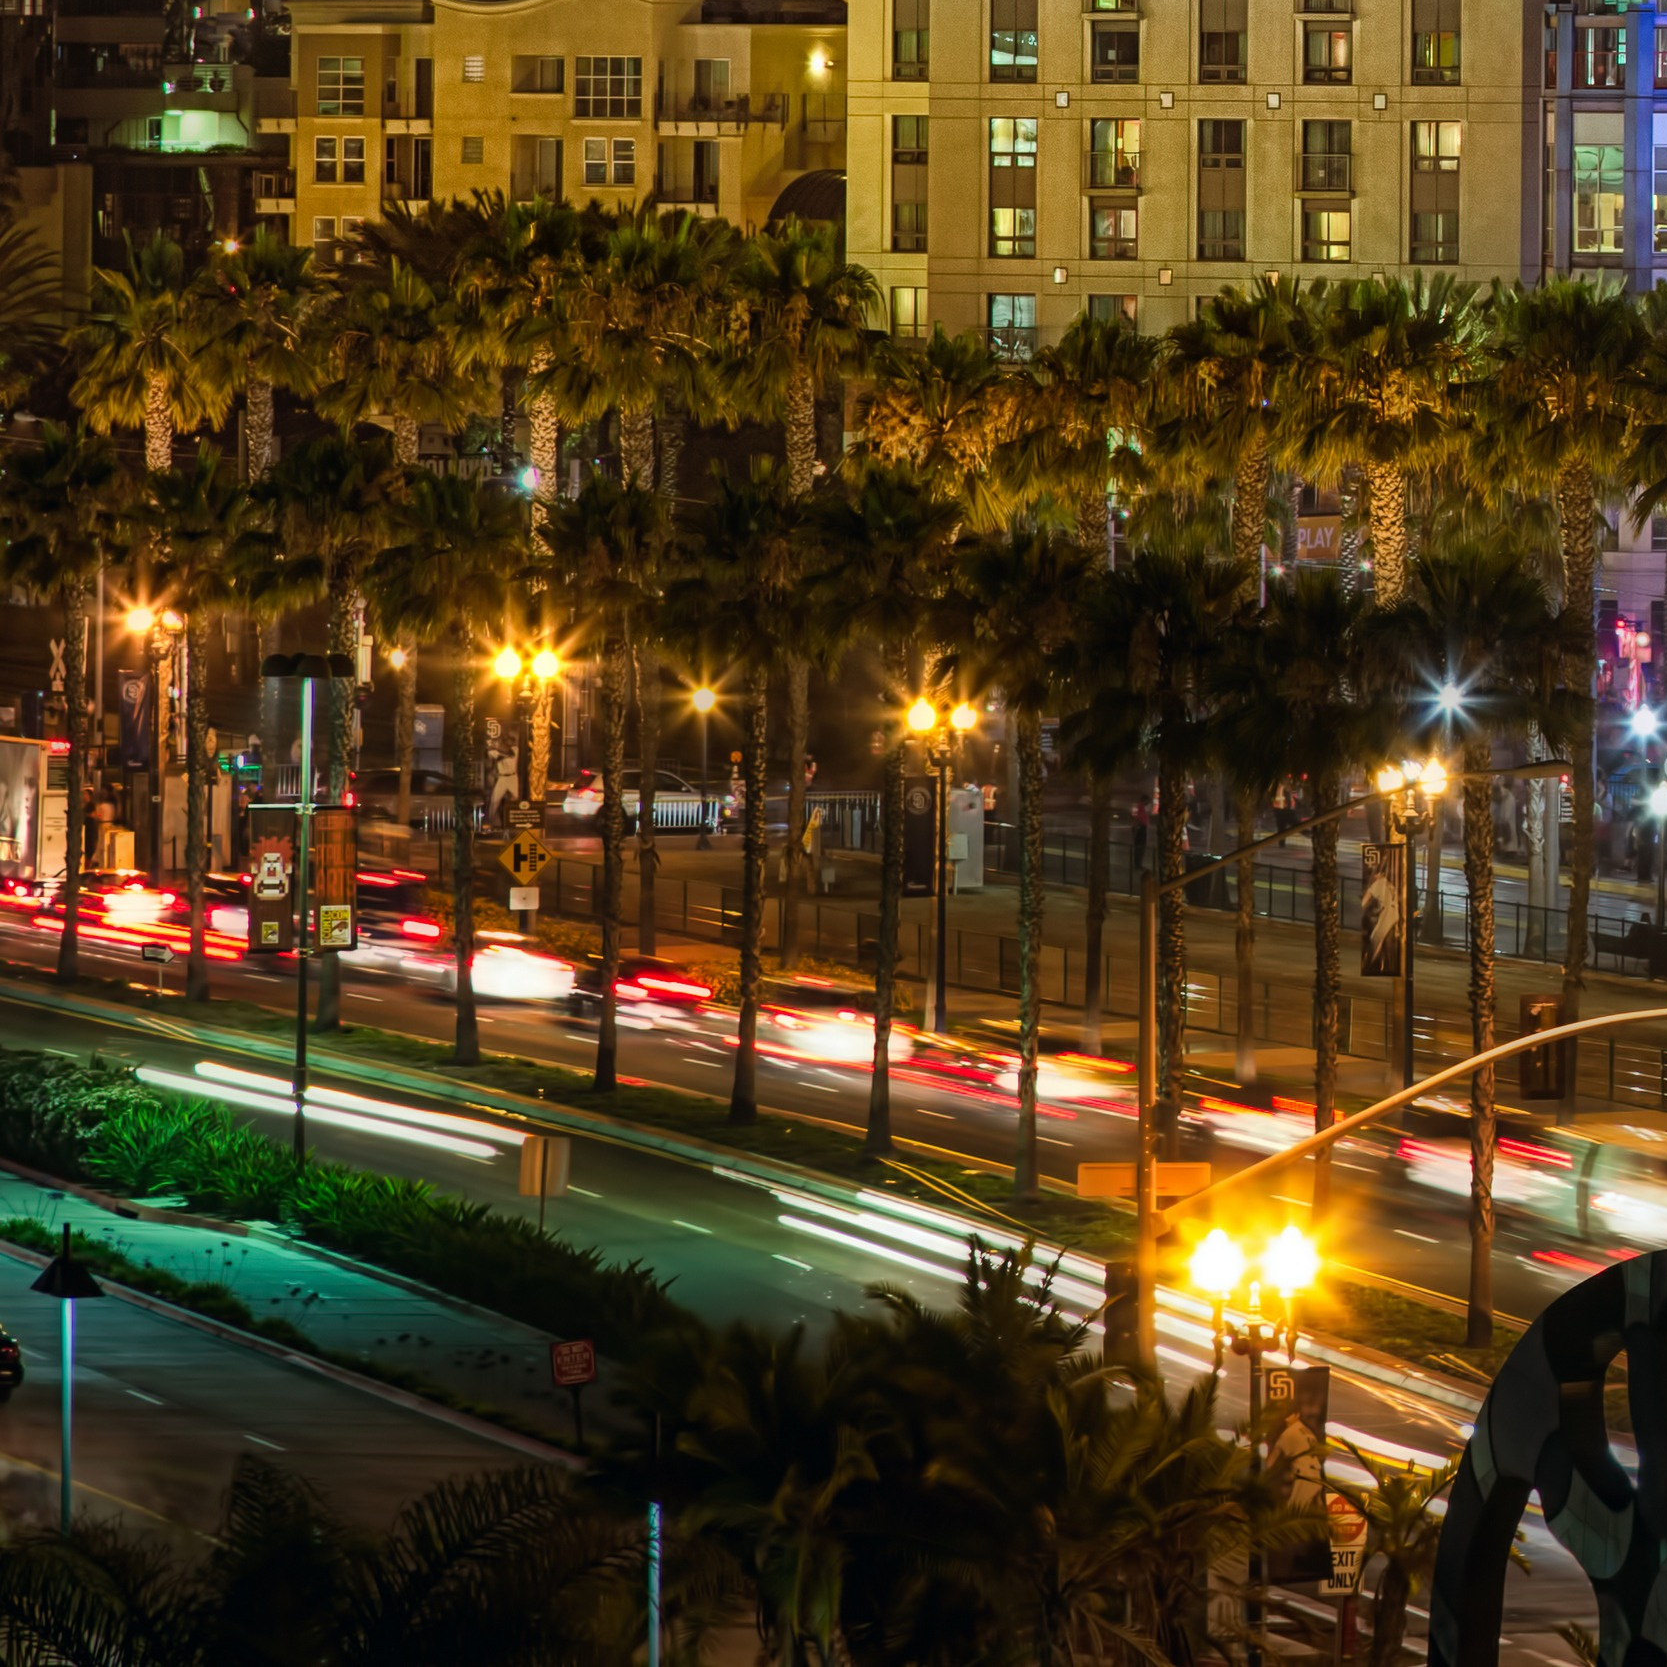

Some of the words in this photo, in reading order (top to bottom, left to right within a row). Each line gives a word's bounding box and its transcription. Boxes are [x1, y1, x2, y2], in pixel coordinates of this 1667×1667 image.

[1297, 526, 1334, 550] PLAY
[1331, 1551, 1357, 1567] EXIT
[1327, 1572, 1357, 1589] ONLY
